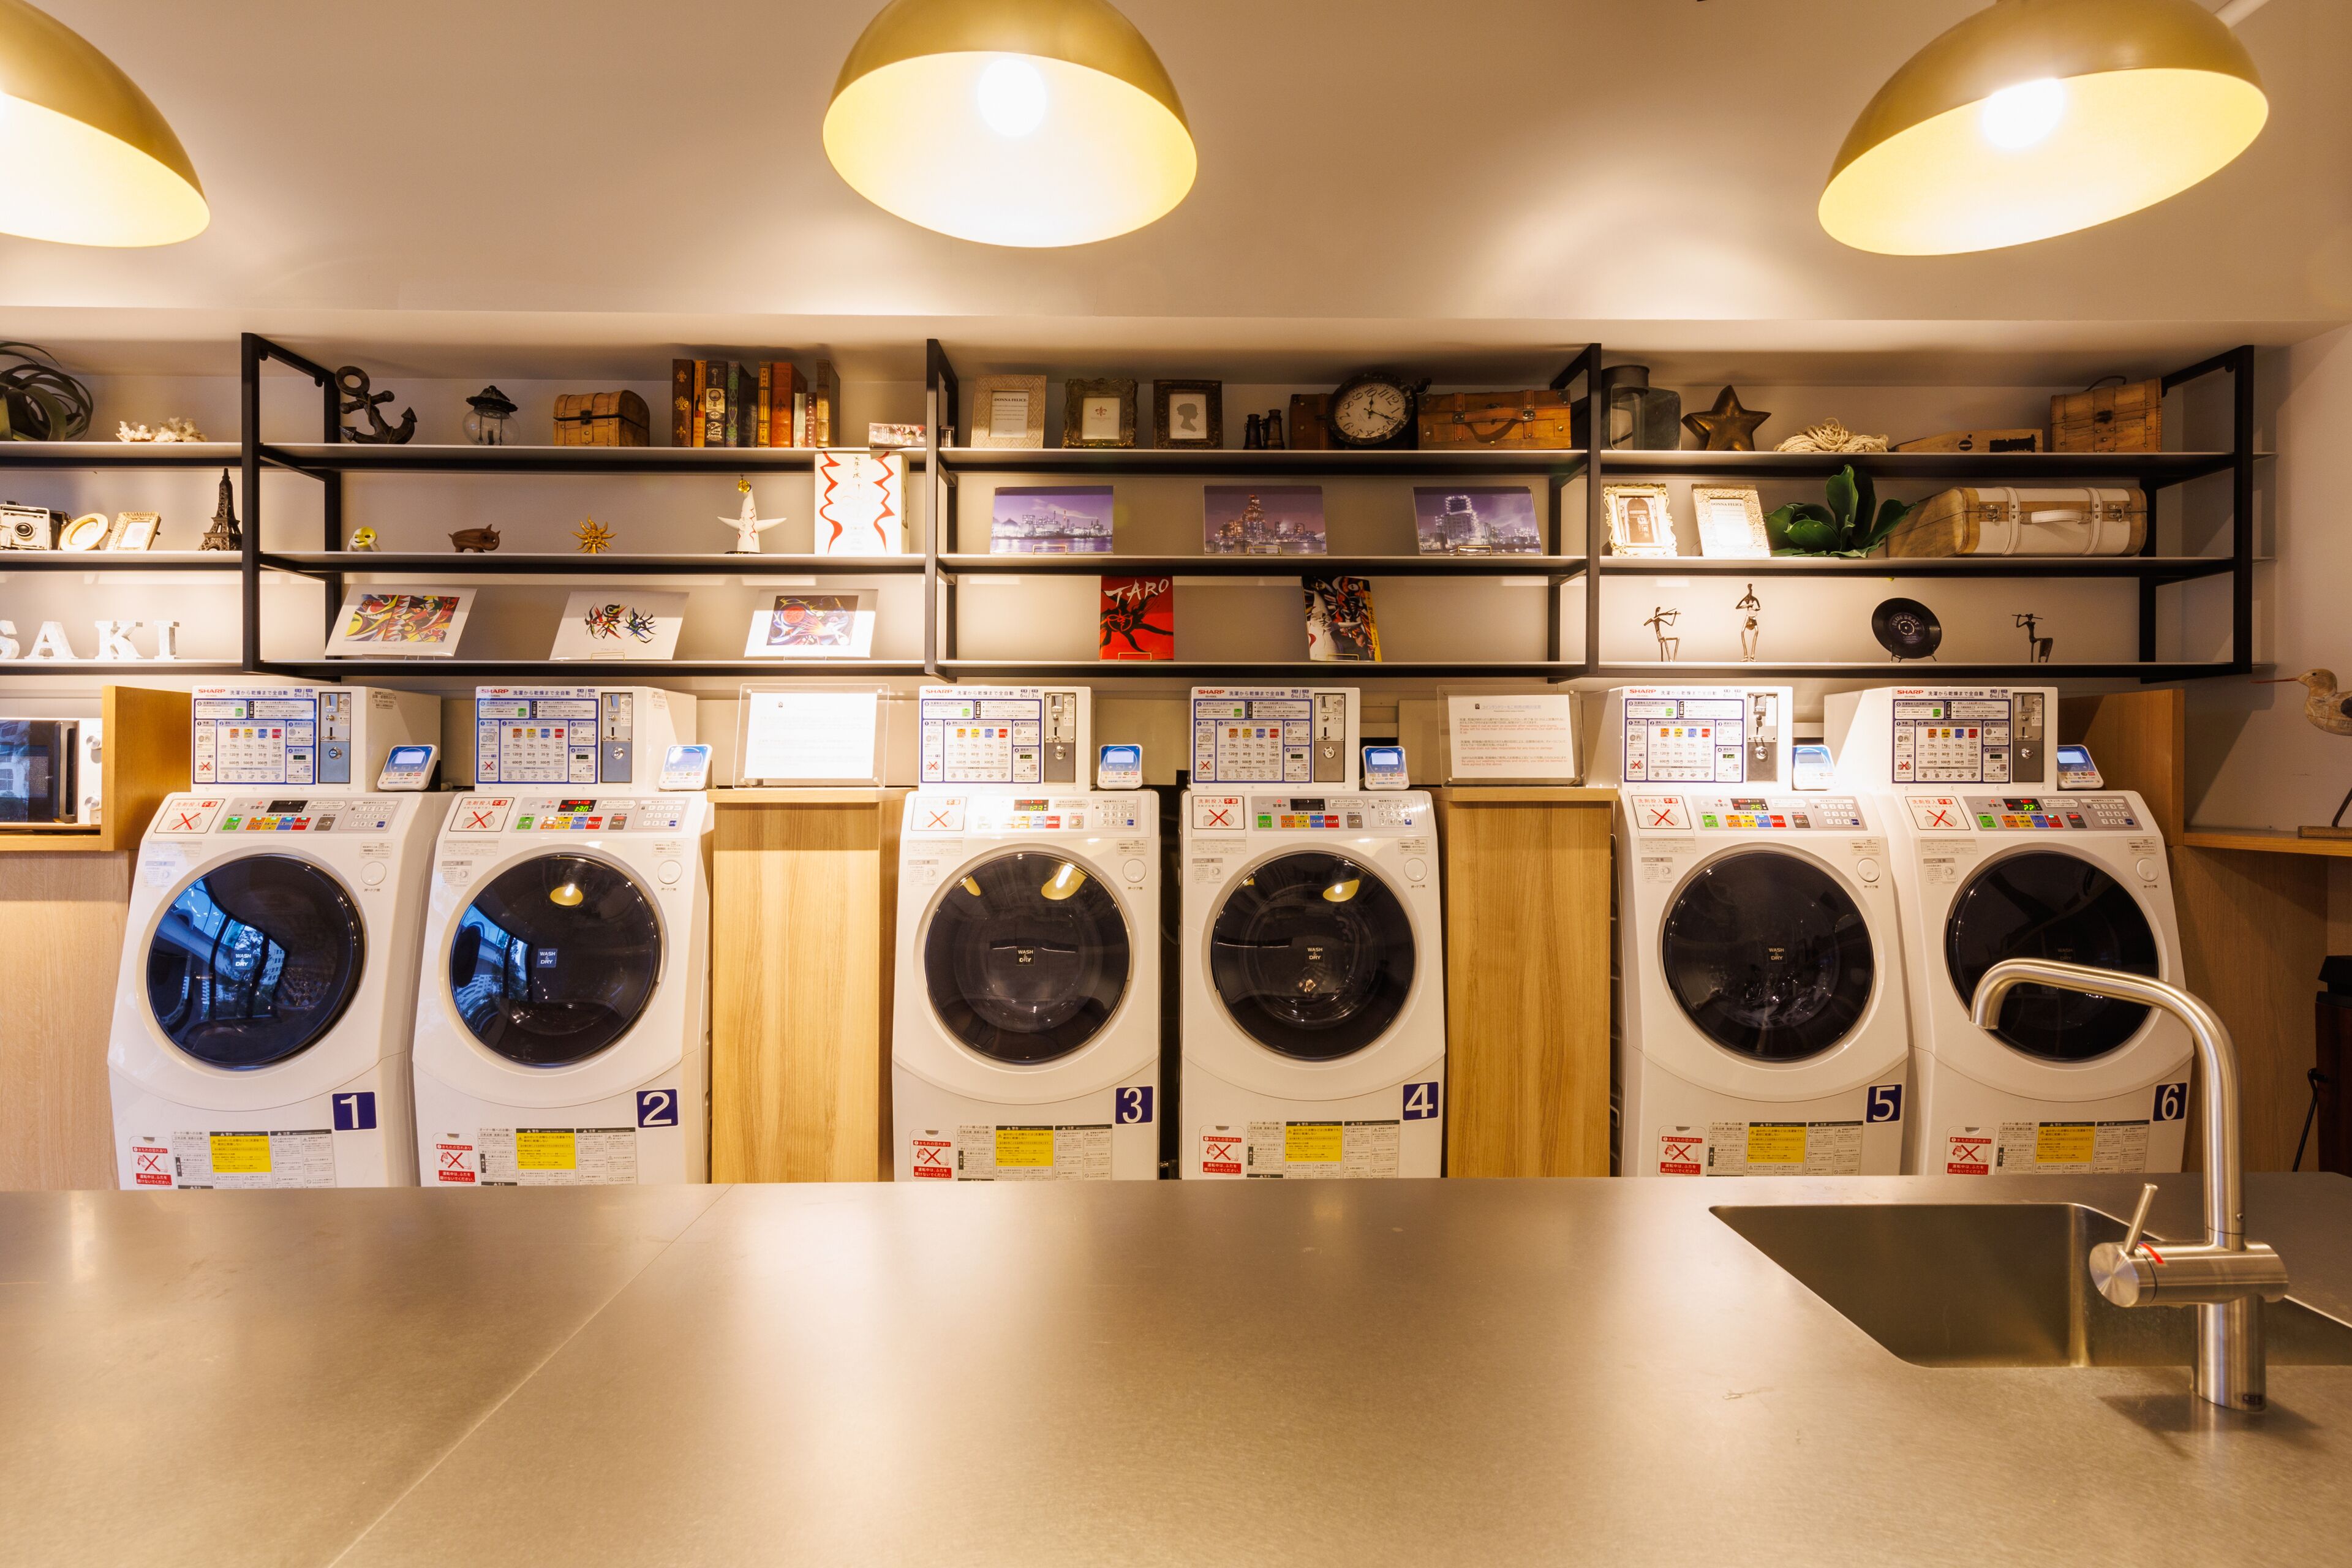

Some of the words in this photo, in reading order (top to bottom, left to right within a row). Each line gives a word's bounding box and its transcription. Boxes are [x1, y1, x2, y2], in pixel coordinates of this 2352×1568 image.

[1365, 387, 1378, 398] 10
[1378, 389, 1389, 398] 11
[1385, 394, 1399, 405] 12
[1377, 425, 1389, 434] 3
[1105, 578, 1170, 606] TARO
[1892, 616, 1903, 626] BLUE
[1904, 615, 1920, 625] BEAT
[340, 1095, 359, 1128] 1
[643, 1091, 672, 1126] 2
[1122, 1087, 1142, 1123] 3
[1405, 1084, 1433, 1118] 4
[1872, 1086, 1896, 1121] 5
[2160, 1084, 2179, 1120] 6
